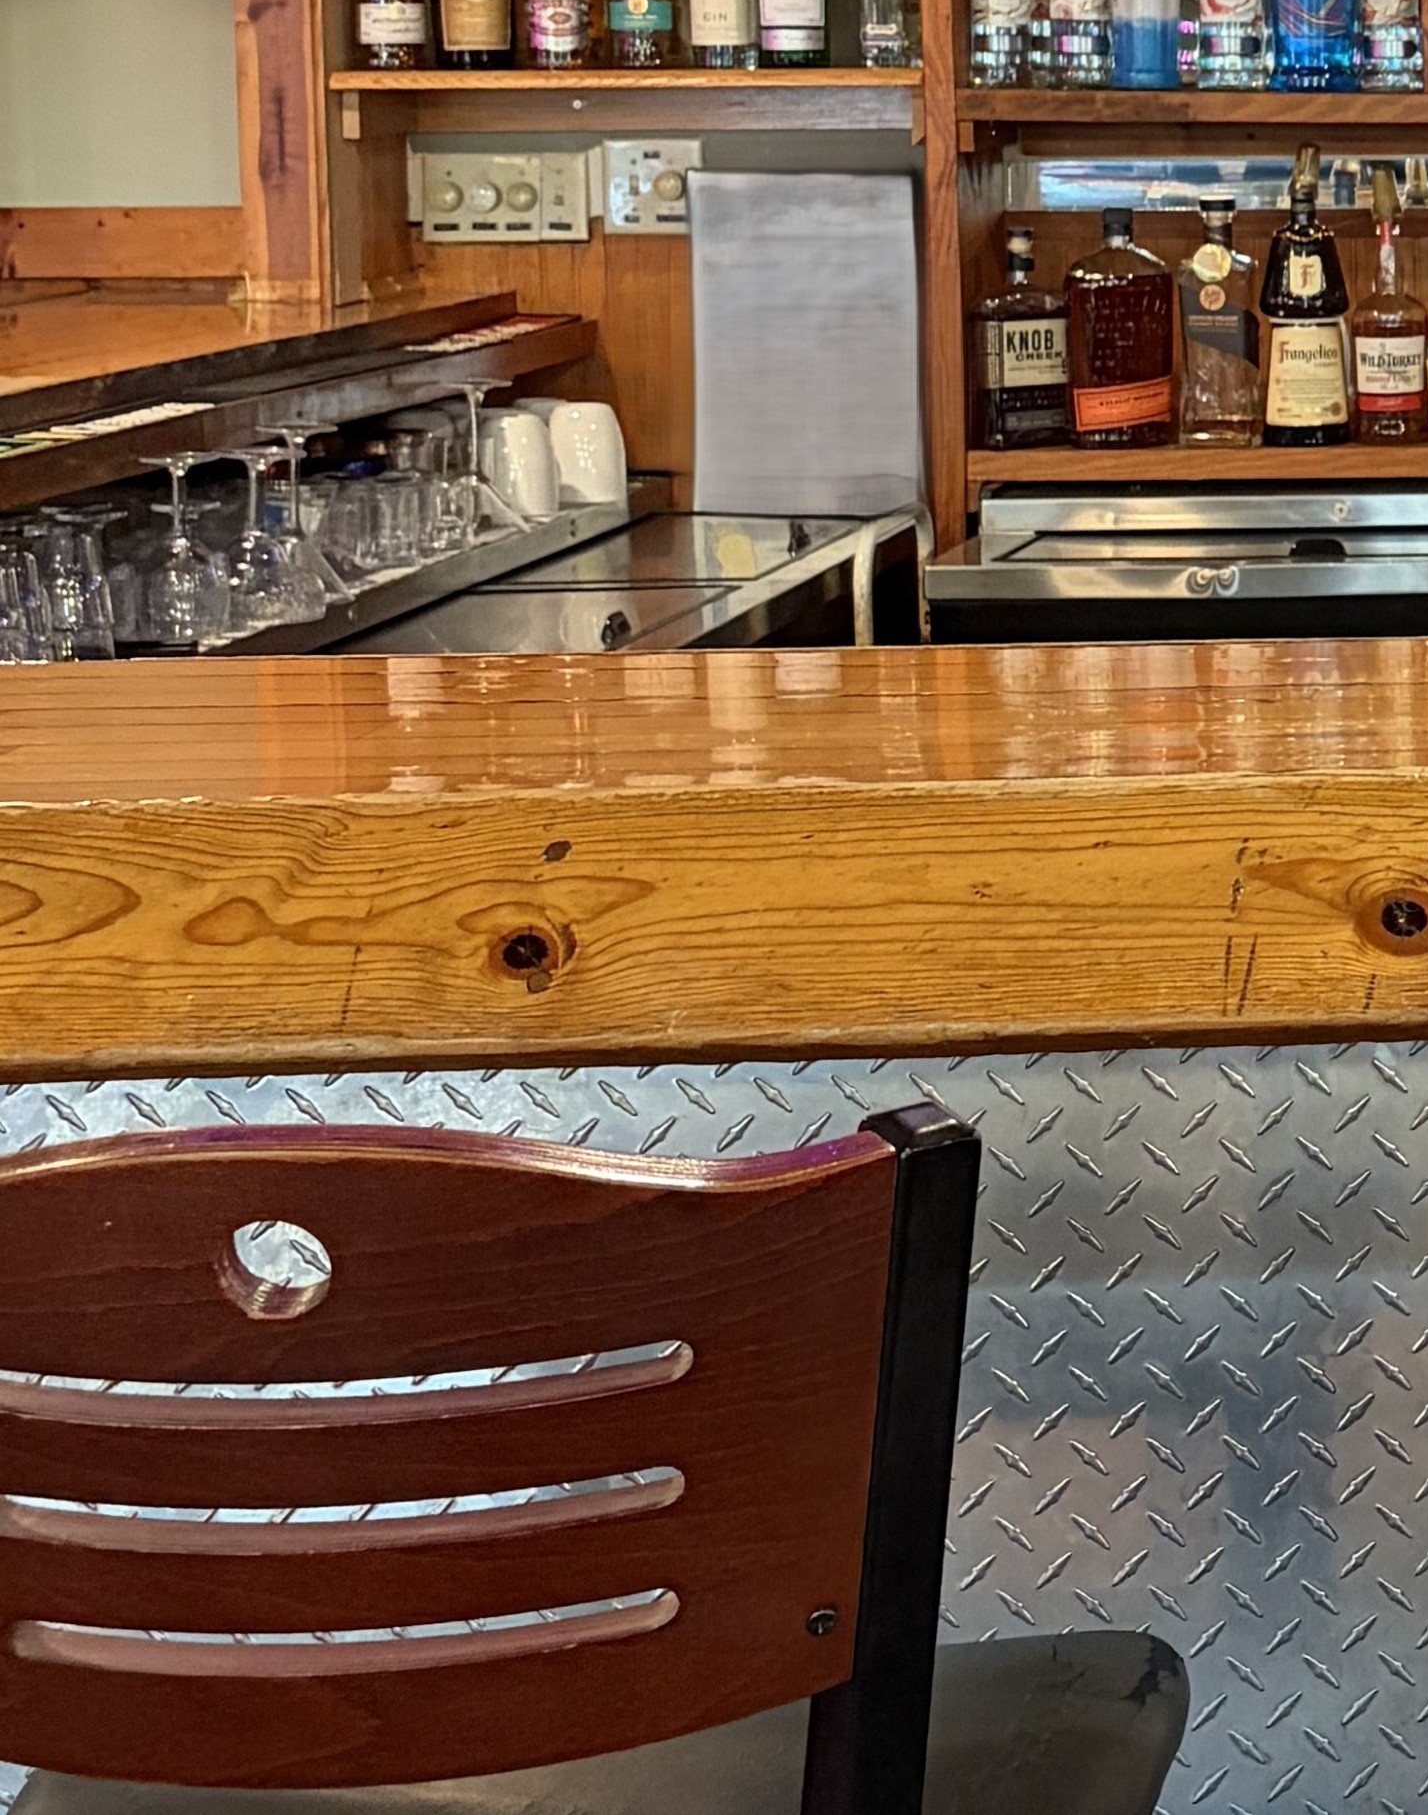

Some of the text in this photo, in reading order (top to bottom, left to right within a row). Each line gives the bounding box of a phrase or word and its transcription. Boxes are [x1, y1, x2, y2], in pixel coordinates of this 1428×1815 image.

[703, 11, 728, 22] GIN
[1299, 263, 1315, 289] F
[1006, 328, 1055, 355] KNOB
[1015, 351, 1064, 362] CREEK
[1278, 341, 1338, 367] Frangelico
[1359, 352, 1421, 368] WILD TURKEY
